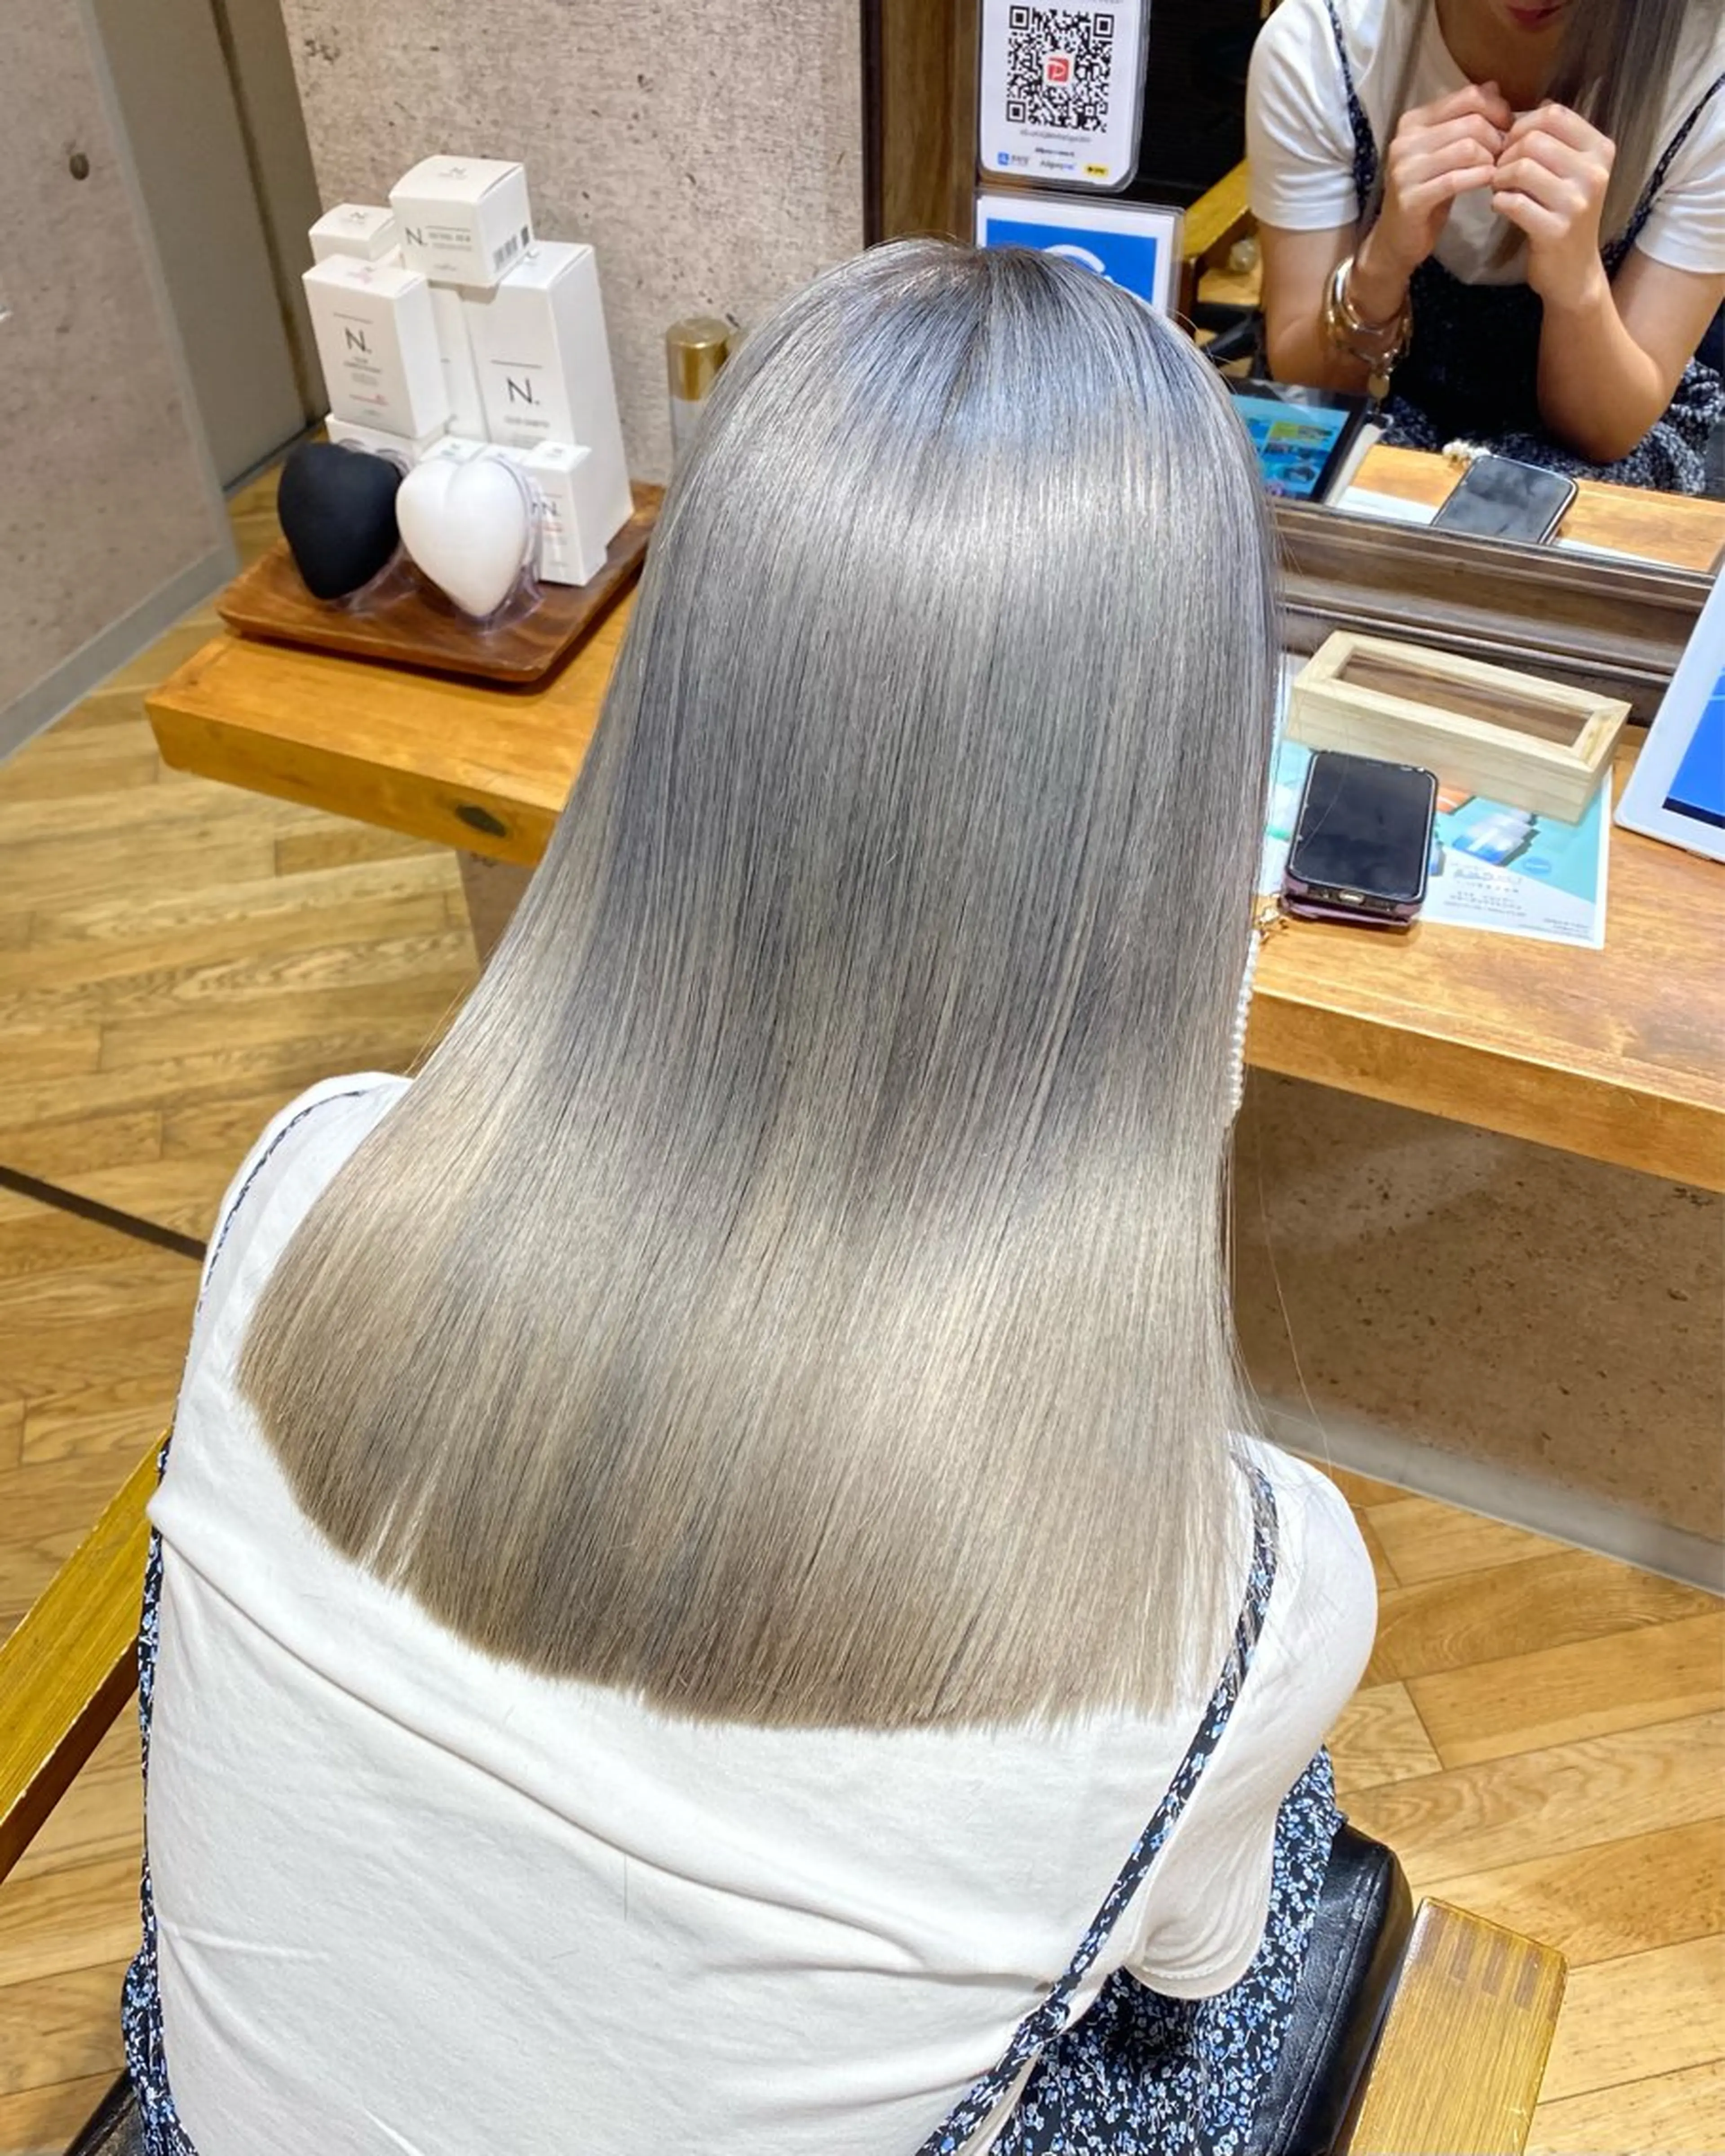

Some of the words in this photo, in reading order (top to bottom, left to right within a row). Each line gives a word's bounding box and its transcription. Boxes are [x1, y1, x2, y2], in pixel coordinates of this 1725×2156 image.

[405, 227, 428, 246] N.
[345, 327, 372, 354] N.
[507, 377, 540, 405] N.
